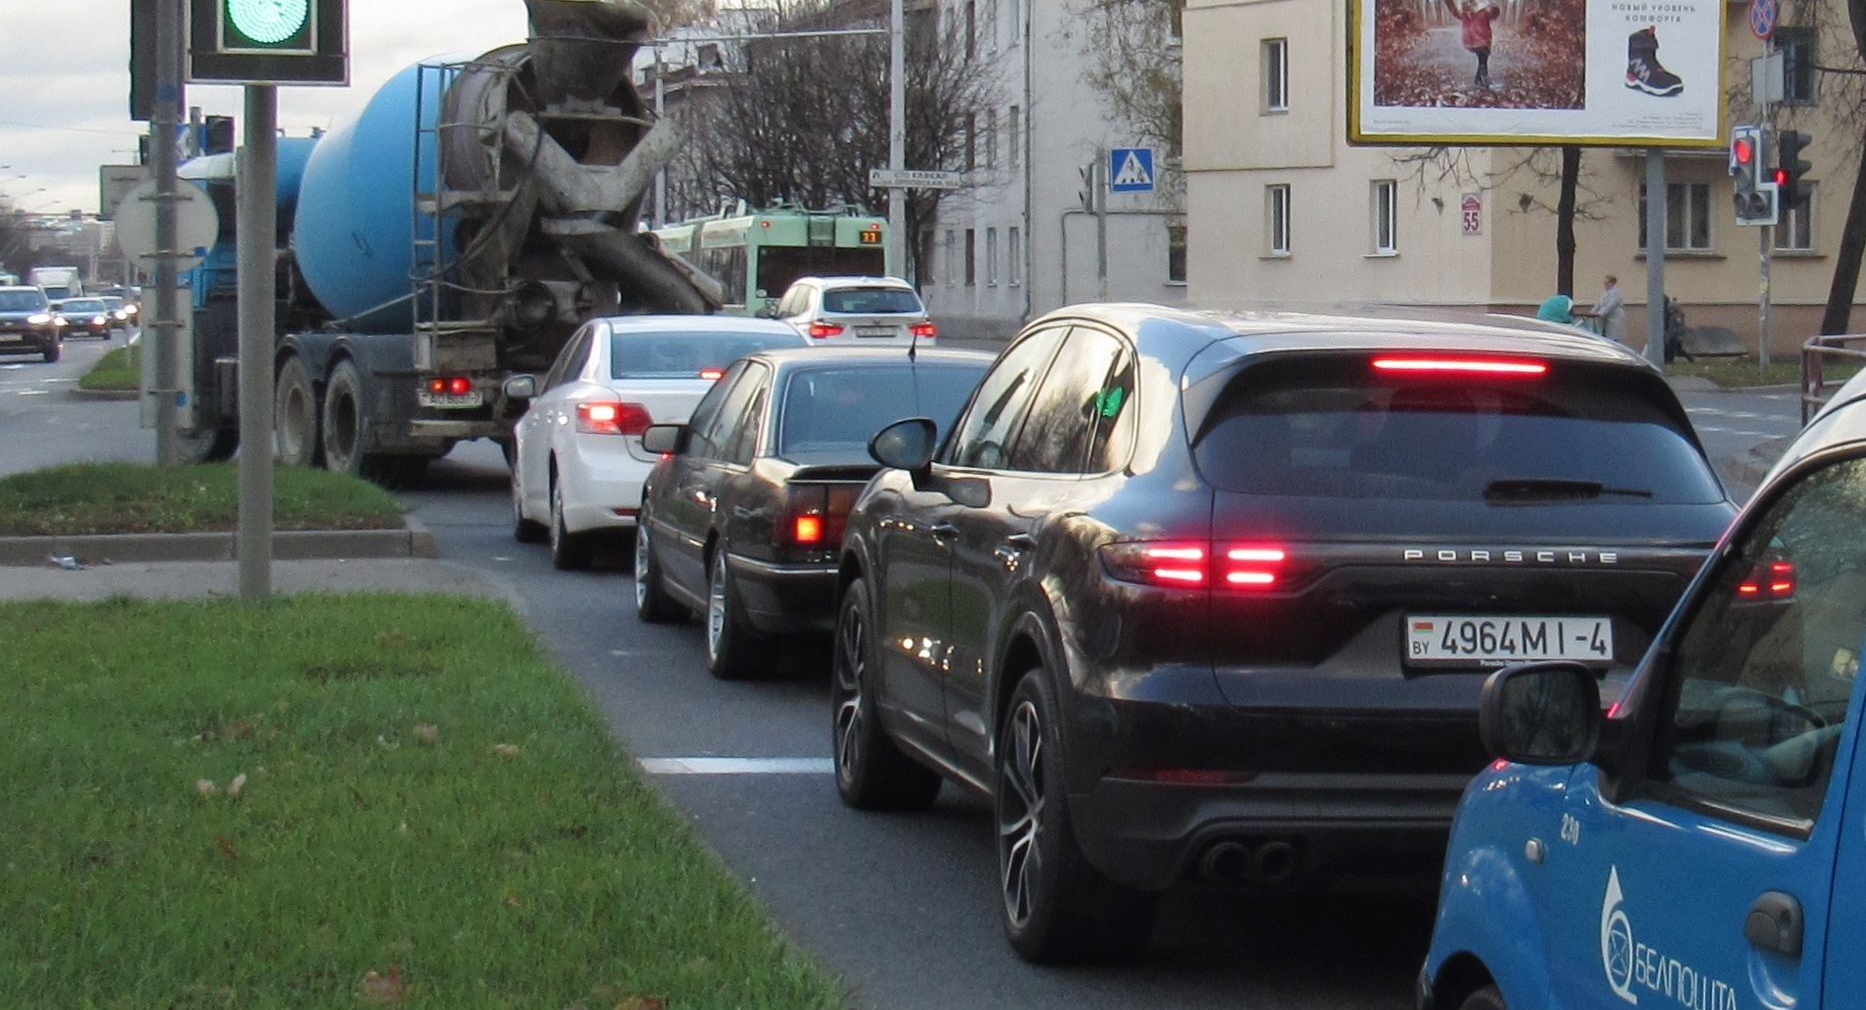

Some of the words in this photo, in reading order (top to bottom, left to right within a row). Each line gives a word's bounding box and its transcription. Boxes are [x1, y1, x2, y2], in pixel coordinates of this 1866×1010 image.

[1611, 3, 1648, 11] НОВЫЙ
[1651, 4, 1695, 12] УРОВЕНЬ
[1625, 15, 1681, 23] КОМФОРТА
[1463, 211, 1479, 232] 55
[862, 231, 877, 242] 33
[1403, 548, 1618, 564] PORSCHE
[1412, 640, 1431, 655] BY
